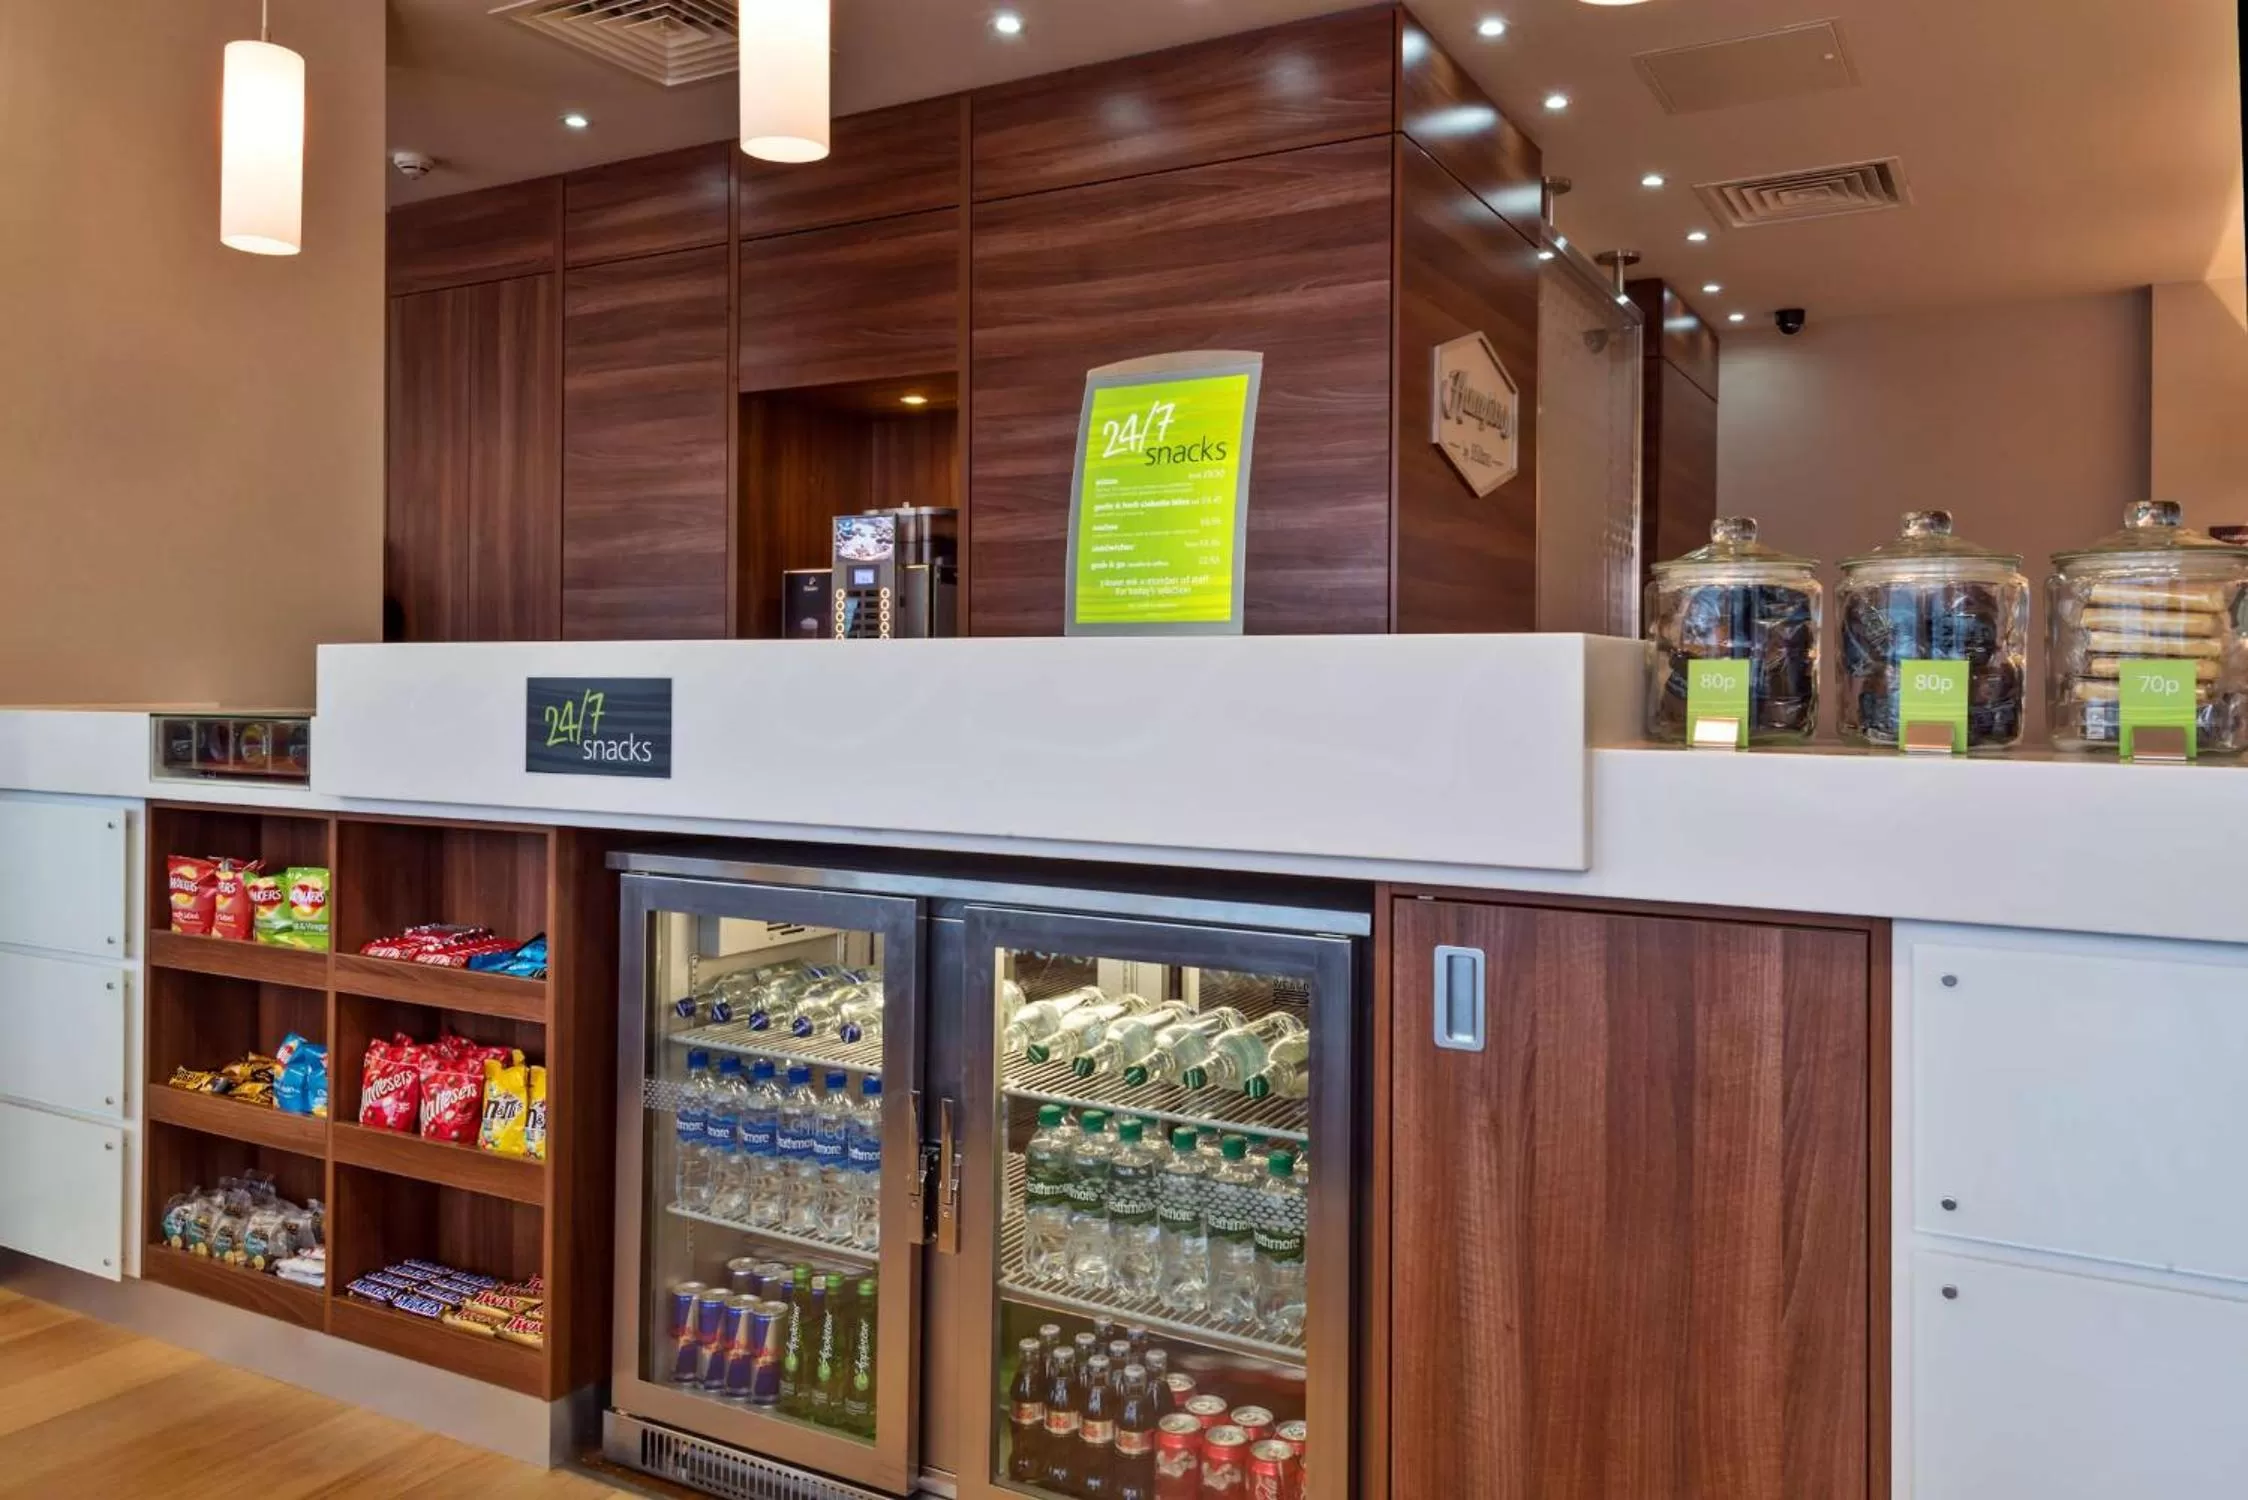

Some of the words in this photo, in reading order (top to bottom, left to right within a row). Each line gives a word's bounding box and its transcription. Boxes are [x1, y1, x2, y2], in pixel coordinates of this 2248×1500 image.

[1102, 400, 1175, 458] 24/7
[1144, 435, 1227, 466] snacks
[1700, 673, 1736, 690] 80p
[1915, 675, 1954, 690] 80p
[2139, 675, 2180, 696] 70p
[545, 688, 605, 746] 24/7
[583, 732, 652, 762] snacks
